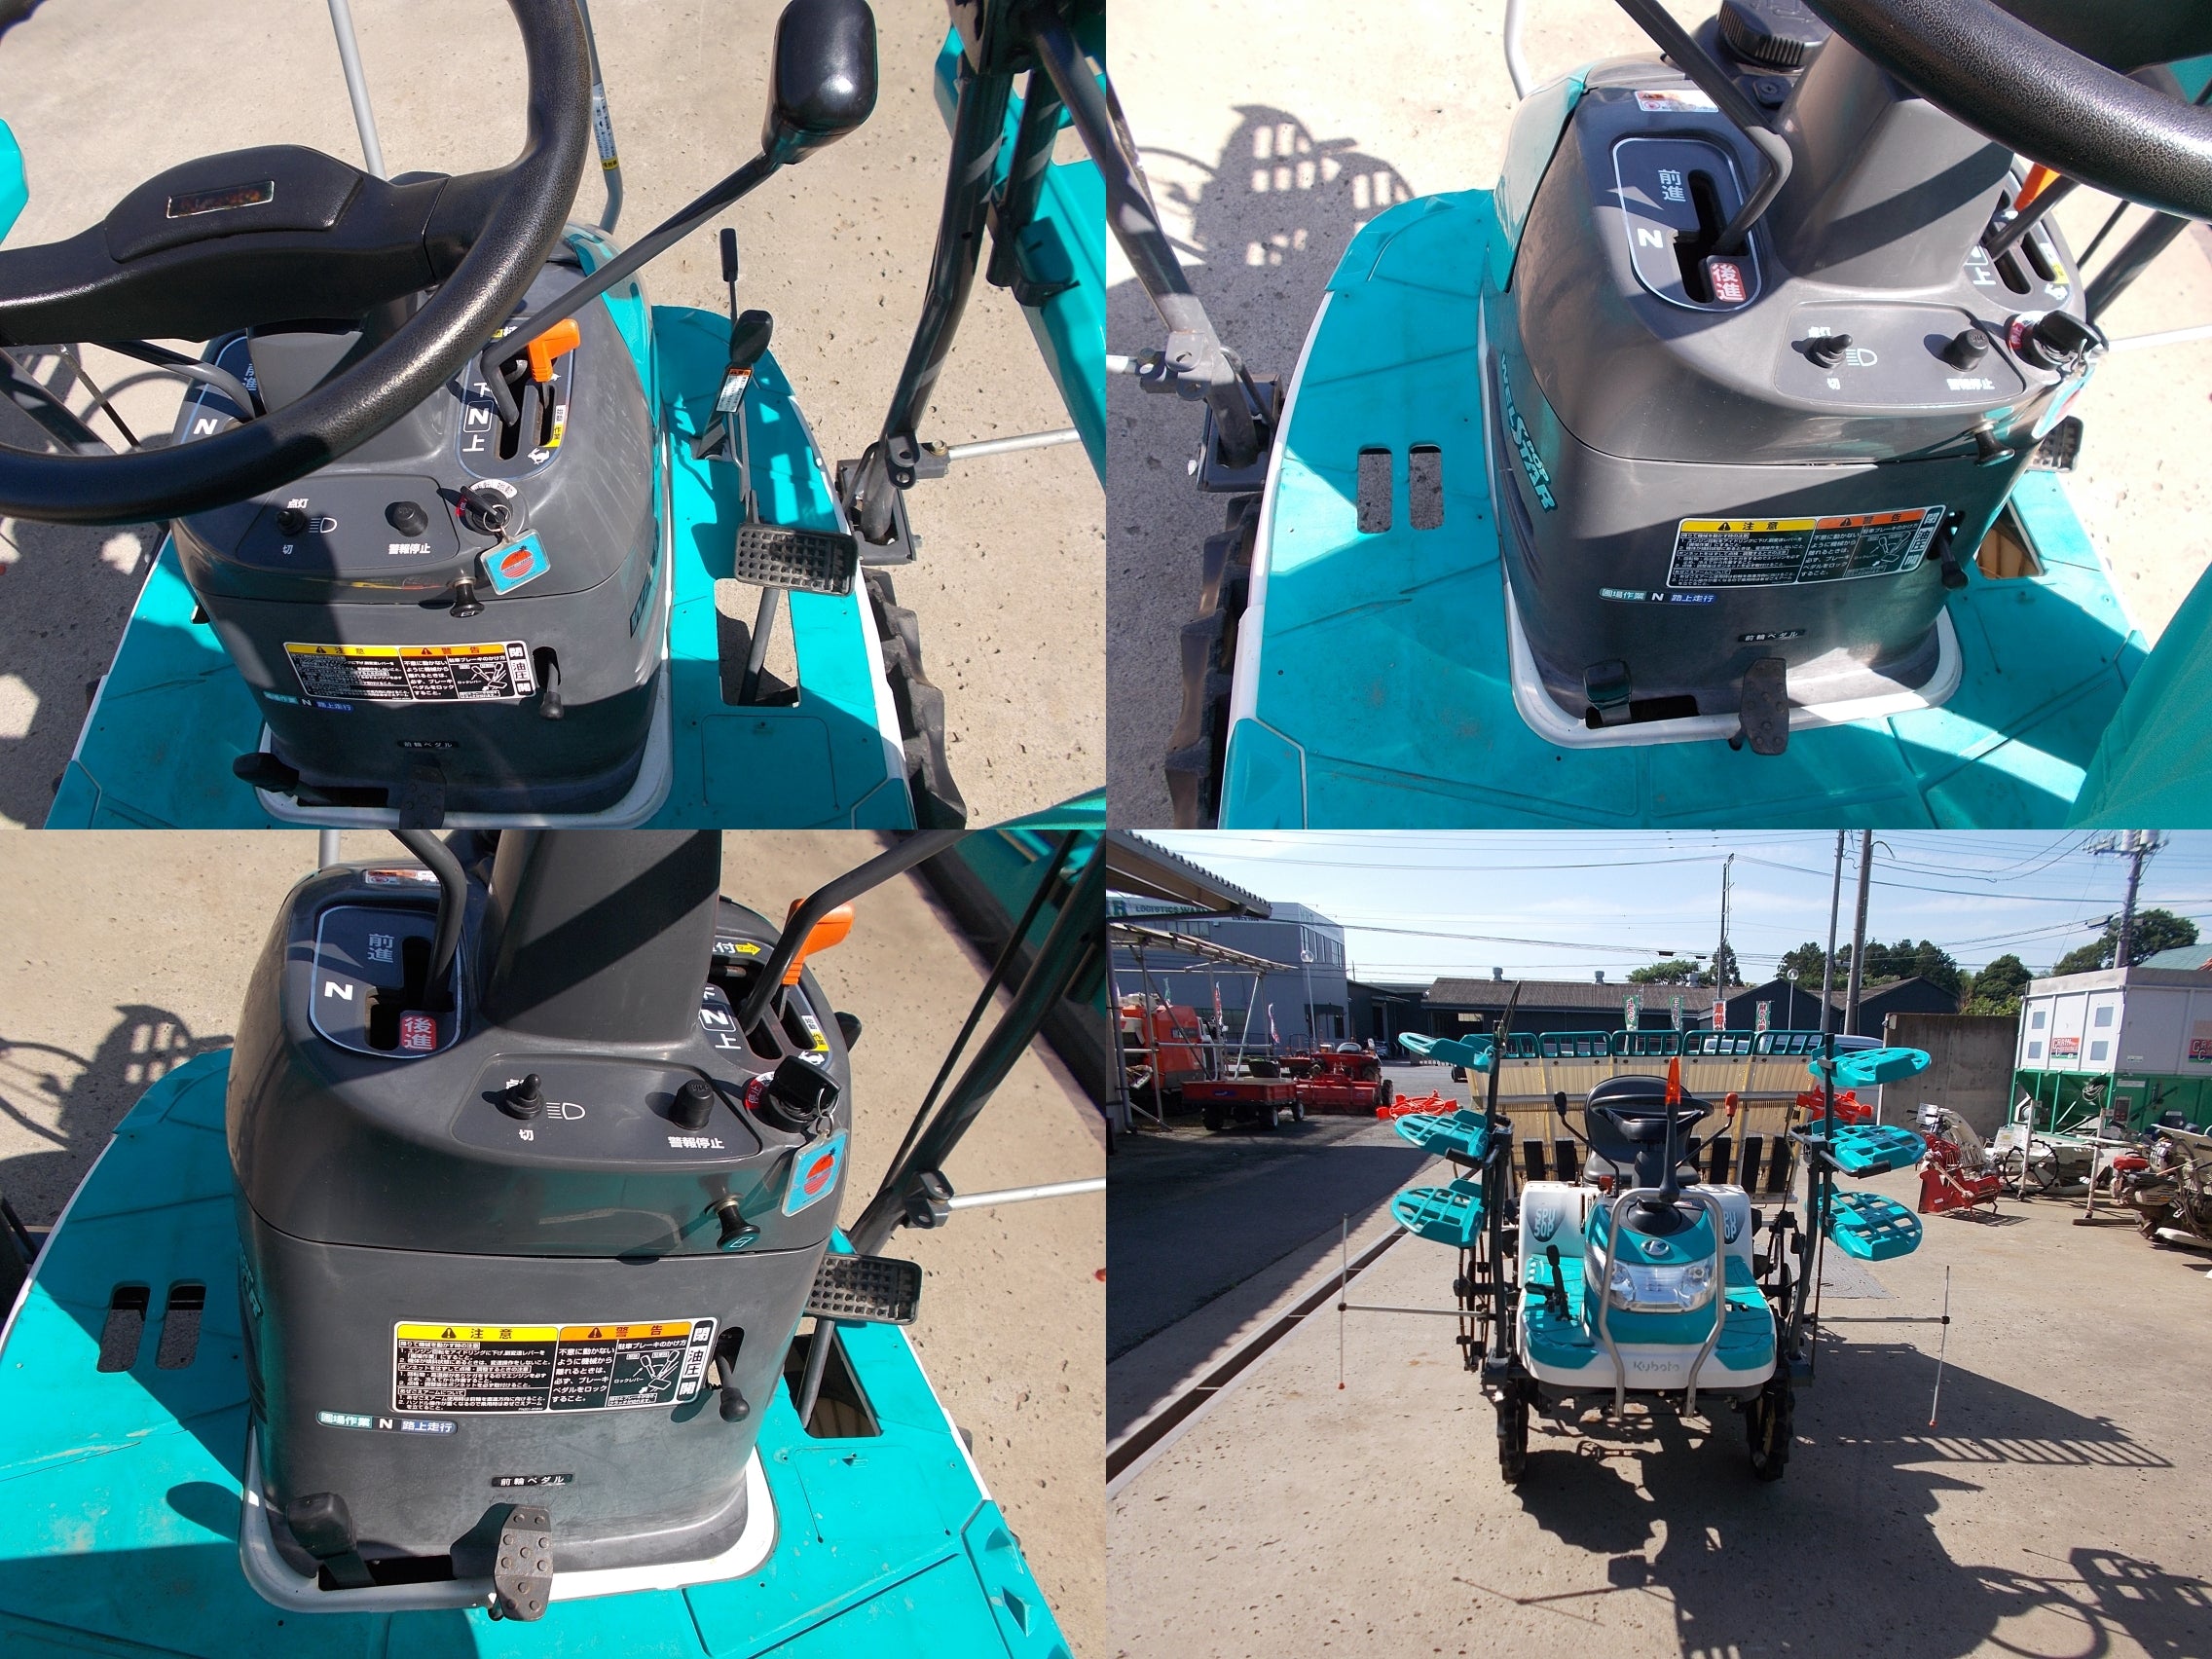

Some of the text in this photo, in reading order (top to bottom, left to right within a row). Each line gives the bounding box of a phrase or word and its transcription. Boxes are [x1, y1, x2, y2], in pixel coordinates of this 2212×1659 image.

[1658, 168, 1686, 203] 前進
[1638, 228, 1664, 249] N
[1712, 263, 1743, 302] 後進
[467, 408, 489, 425] N
[193, 418, 218, 435] N
[462, 434, 485, 452] 上
[1742, 521, 1779, 532] 注意
[388, 543, 430, 555] 警報停止
[1651, 593, 1664, 602] N
[1671, 593, 1714, 603] 路上走行
[367, 934, 395, 963] 前進
[324, 980, 353, 1001] N
[404, 1016, 433, 1051] 後進
[715, 1033, 742, 1050] 上
[519, 1128, 534, 1141] 切
[668, 1136, 724, 1149] 警報停止
[1535, 1208, 1556, 1221] SPU
[1724, 1211, 1737, 1224] PU
[1533, 1218, 1555, 1237] 50P
[1724, 1223, 1737, 1239] 0P
[470, 1328, 513, 1340] 注意
[615, 1324, 663, 1338] 警告
[693, 1327, 710, 1342] 閉
[558, 1346, 615, 1355] 不意に動かない
[617, 1339, 686, 1349] 駐車ブレーキのかけ方
[684, 1348, 705, 1377] 油圧
[1634, 1360, 1680, 1372] Kubota
[554, 1376, 609, 1384] 必ず、ブレーキ
[679, 1382, 696, 1396] 開
[379, 1419, 393, 1429] N
[402, 1420, 453, 1433] 路上走行
[500, 1475, 565, 1487] 前輪ペダル
